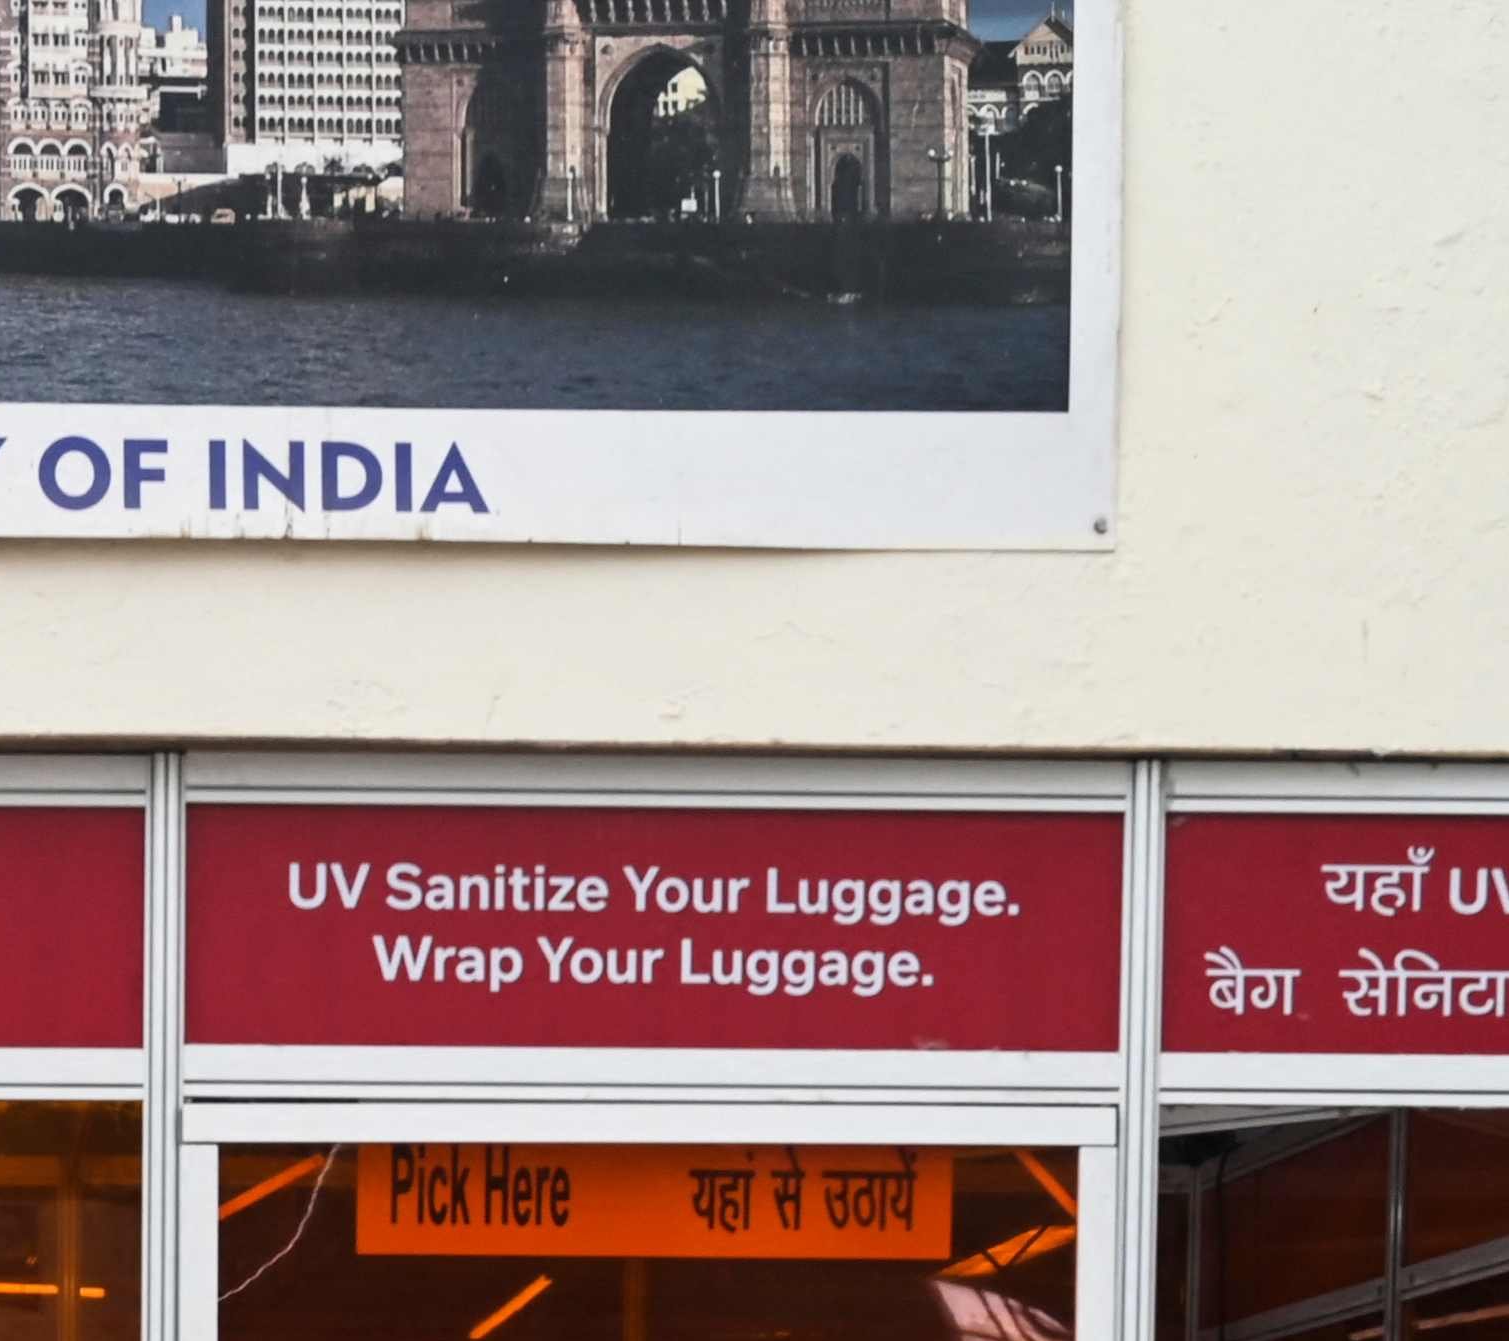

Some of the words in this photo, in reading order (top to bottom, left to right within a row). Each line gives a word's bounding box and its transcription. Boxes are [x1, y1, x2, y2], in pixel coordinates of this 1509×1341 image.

[37, 435, 172, 513] OF
[204, 436, 489, 517] INDIA
[287, 862, 371, 912] UV
[384, 863, 610, 914] Sanitize
[623, 864, 750, 915] Your
[764, 867, 1021, 927] Luggage.
[1321, 845, 1435, 916] यहाँ
[371, 935, 524, 995] Wrap
[536, 936, 664, 987] Your
[678, 939, 935, 998] Luggage.
[1204, 945, 1301, 1018] बैग
[389, 1144, 468, 1227] Pick
[483, 1145, 571, 1229] Here
[689, 1149, 753, 1234] यहां
[771, 1151, 805, 1231] से
